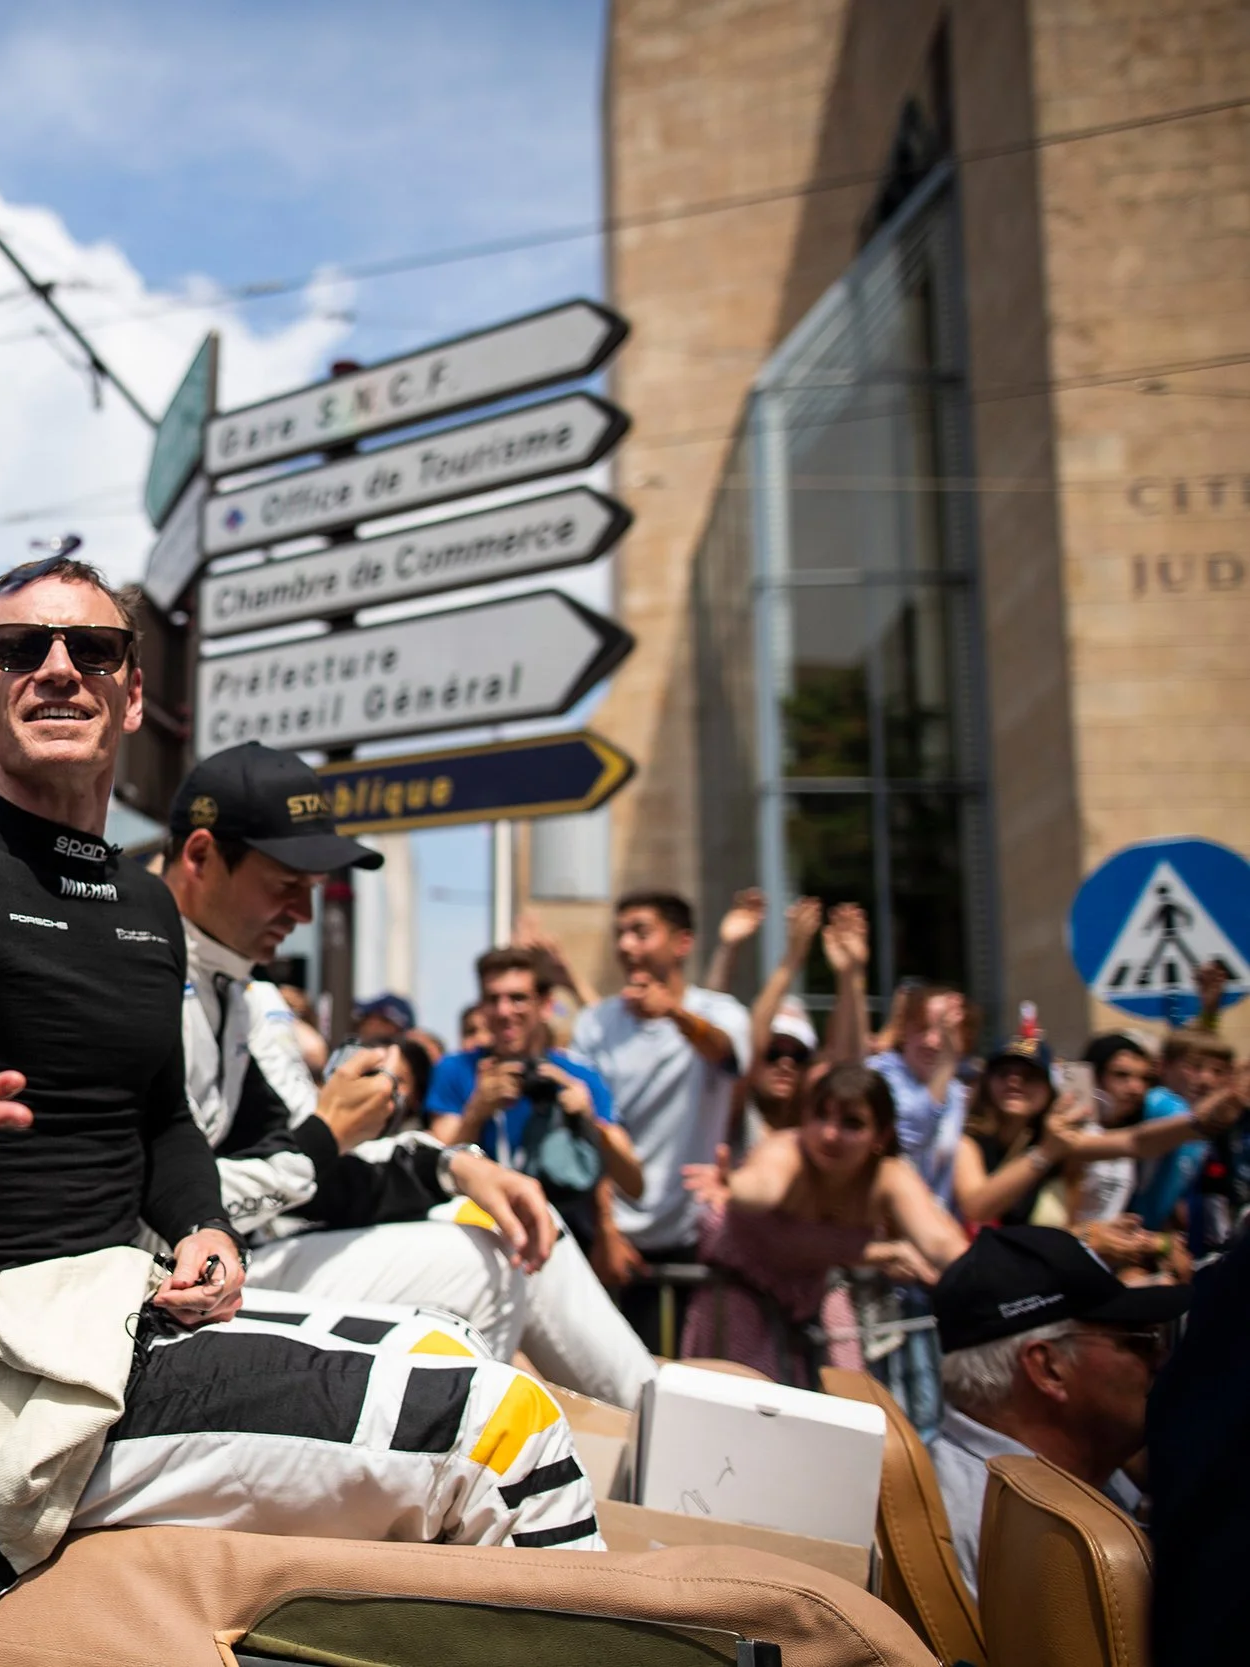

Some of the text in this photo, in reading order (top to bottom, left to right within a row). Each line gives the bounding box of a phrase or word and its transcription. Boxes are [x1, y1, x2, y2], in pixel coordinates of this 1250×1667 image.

[217, 415, 296, 459] Gare
[260, 421, 573, 527] Office de Tourisme
[212, 514, 577, 620] Chambre de Commerce
[208, 661, 524, 745] Conseil Général
[209, 645, 399, 704] Préfecture
[9, 912, 69, 931] PORSCHE
